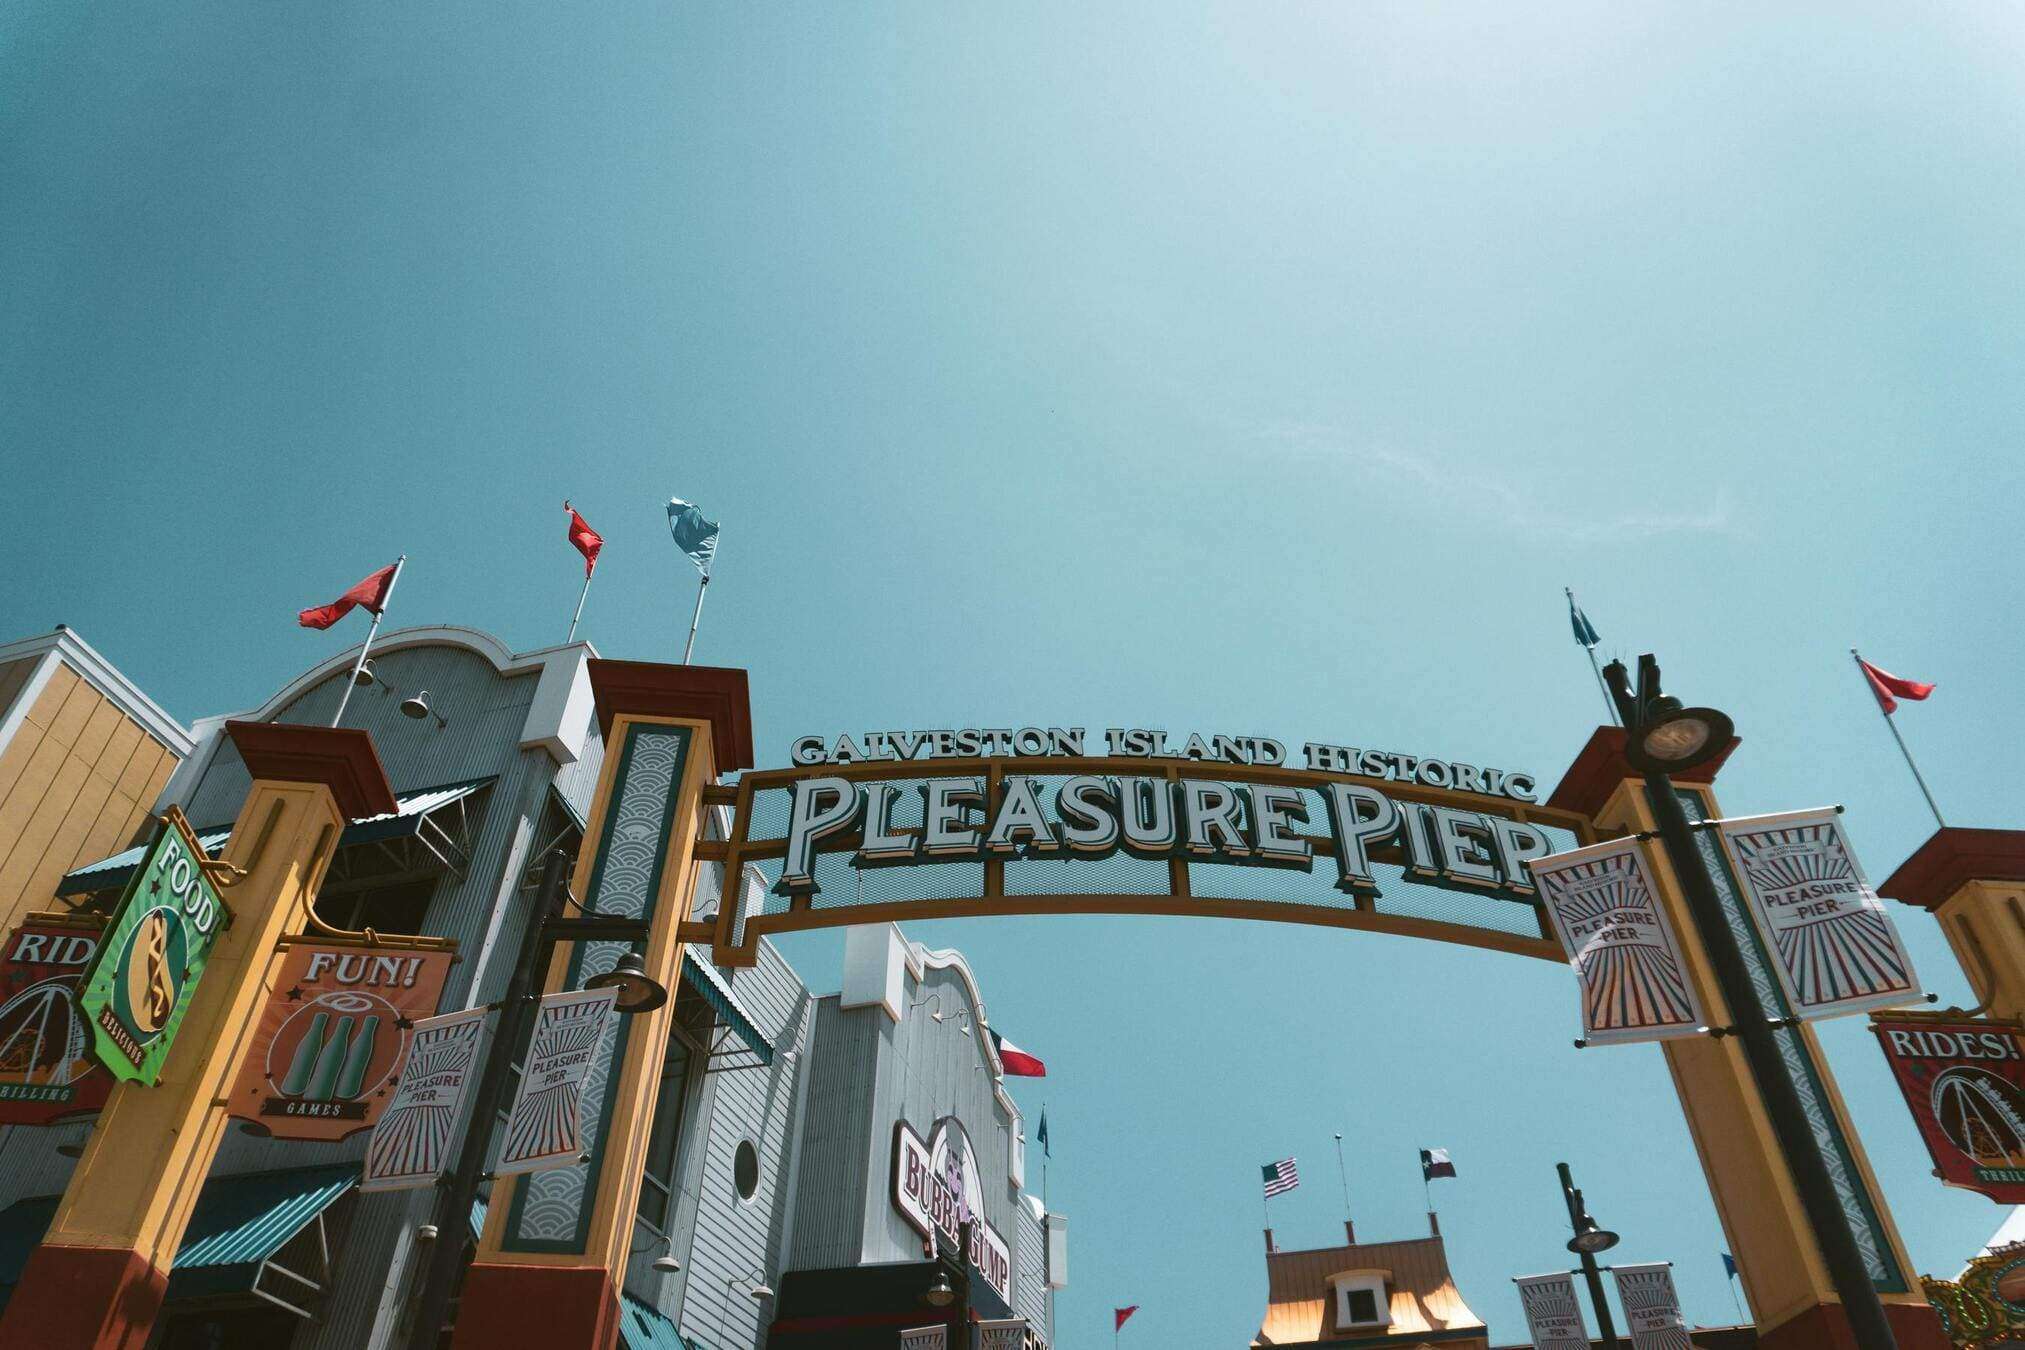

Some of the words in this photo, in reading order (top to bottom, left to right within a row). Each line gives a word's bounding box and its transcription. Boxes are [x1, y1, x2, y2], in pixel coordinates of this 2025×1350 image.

[791, 727, 1085, 767] GALVESTON
[1105, 727, 1287, 767] ISLAND
[1302, 742, 1539, 802] HISTORIC
[781, 776, 1314, 886] PLEASURE
[1327, 782, 1556, 896] PIER
[1763, 882, 1858, 908] PLEASURE
[1797, 898, 1841, 919] PIER
[1571, 911, 1656, 938] PLEASURE
[1601, 927, 1640, 942] PIER
[9, 933, 97, 964] RID
[303, 952, 424, 988] FUN!
[102, 1011, 142, 1064] DELICIOUS
[1886, 1030, 2021, 1060] RIDES!
[532, 1051, 590, 1074] PLEASURE
[401, 1075, 462, 1095] PLEASURE
[544, 1069, 567, 1086] PIER
[0, 1086, 70, 1101] RILLING
[410, 1089, 437, 1103] PIER
[286, 1101, 342, 1116] GAMES
[1980, 1170, 2025, 1182] THRIL
[968, 1215, 1009, 1294] GUMP
